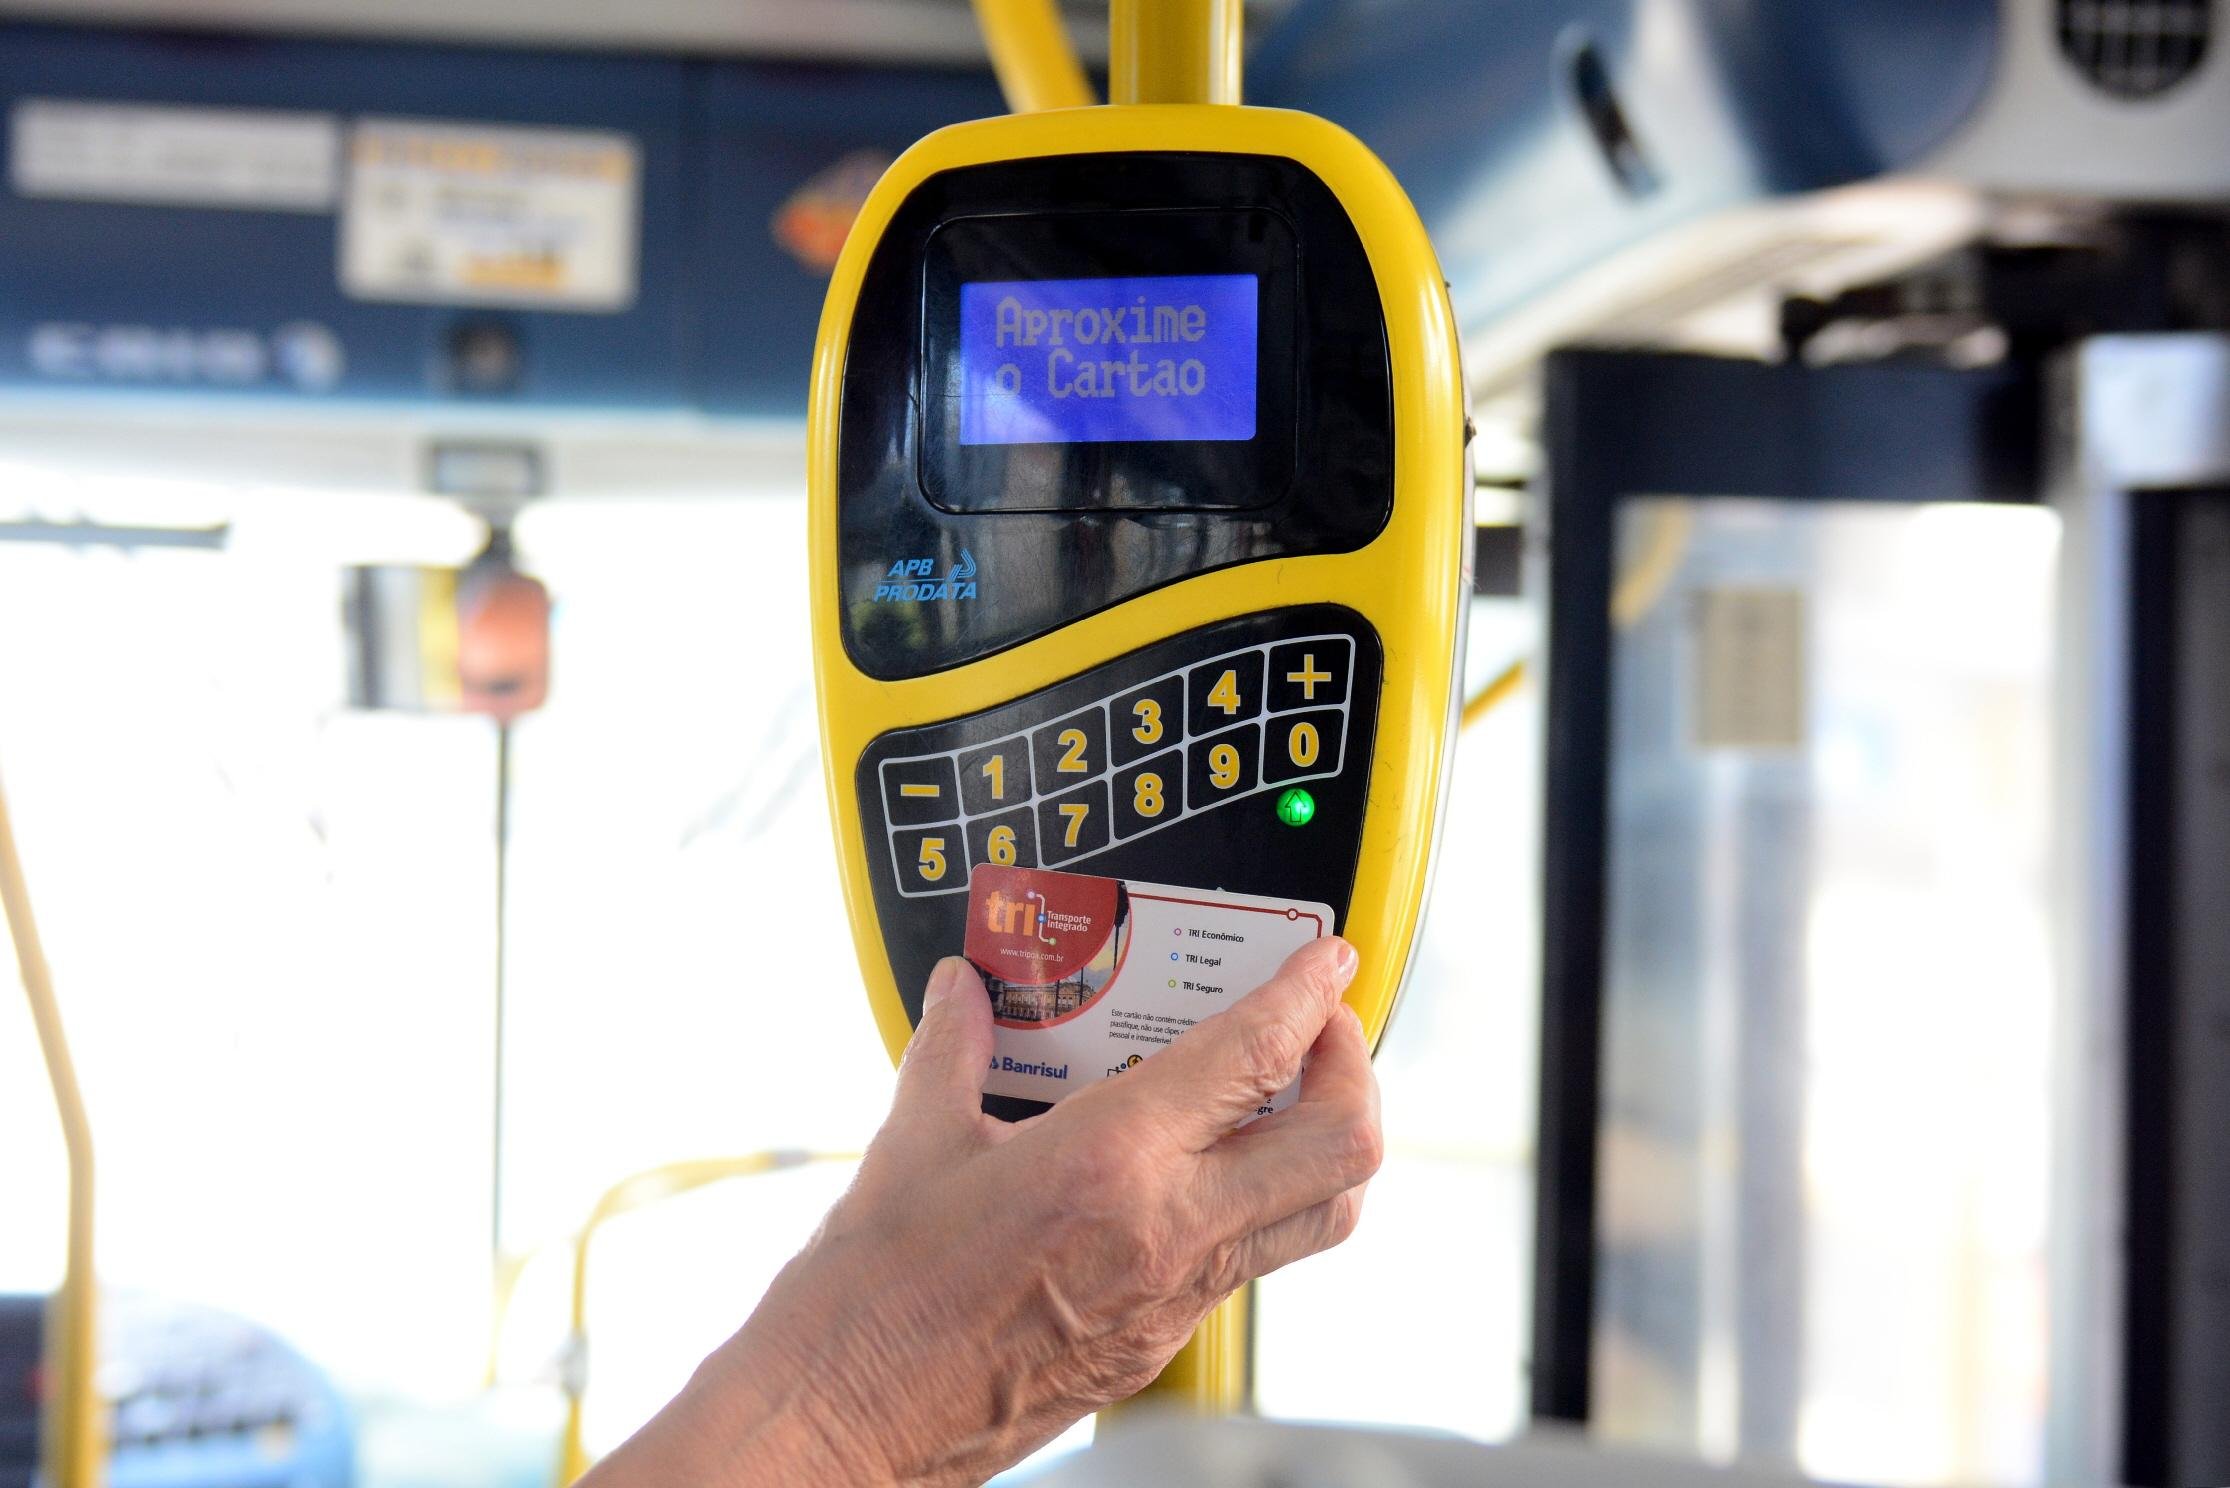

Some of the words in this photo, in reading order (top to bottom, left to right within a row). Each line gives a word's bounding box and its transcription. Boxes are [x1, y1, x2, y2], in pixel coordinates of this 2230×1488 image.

[996, 296, 1206, 347] Aproxime
[996, 363, 1022, 396] o
[1048, 348, 1206, 398] Cartao
[887, 558, 934, 577] APB
[873, 582, 977, 602] PRODATA
[982, 755, 1004, 799] 1
[1057, 729, 1088, 773] 2
[1132, 698, 1164, 745] 3
[1208, 669, 1241, 715] 4
[918, 838, 947, 881] 5
[987, 825, 1017, 866] 6
[1058, 804, 1089, 847] 7
[1133, 772, 1164, 818] 8
[1208, 743, 1241, 790] 9
[1288, 722, 1320, 767] 0
[985, 890, 1036, 937] tri
[1047, 910, 1092, 925] Transporte
[1047, 921, 1088, 932] Integrado
[1188, 928, 1200, 938] TRI
[1202, 930, 1244, 943] Econômico
[1186, 954, 1198, 963] TRI
[1200, 956, 1221, 967] Legal
[1183, 981, 1194, 991] TRI
[1196, 983, 1223, 994] Seguro
[1111, 1008, 1123, 1017] Este
[1123, 1012, 1142, 1020] cartão
[1142, 1013, 1154, 1021] não
[1109, 1031, 1130, 1039] pessoal
[1140, 1023, 1152, 1032] não
[1152, 1026, 1164, 1034] use
[1002, 1056, 1068, 1079] Banrisul
